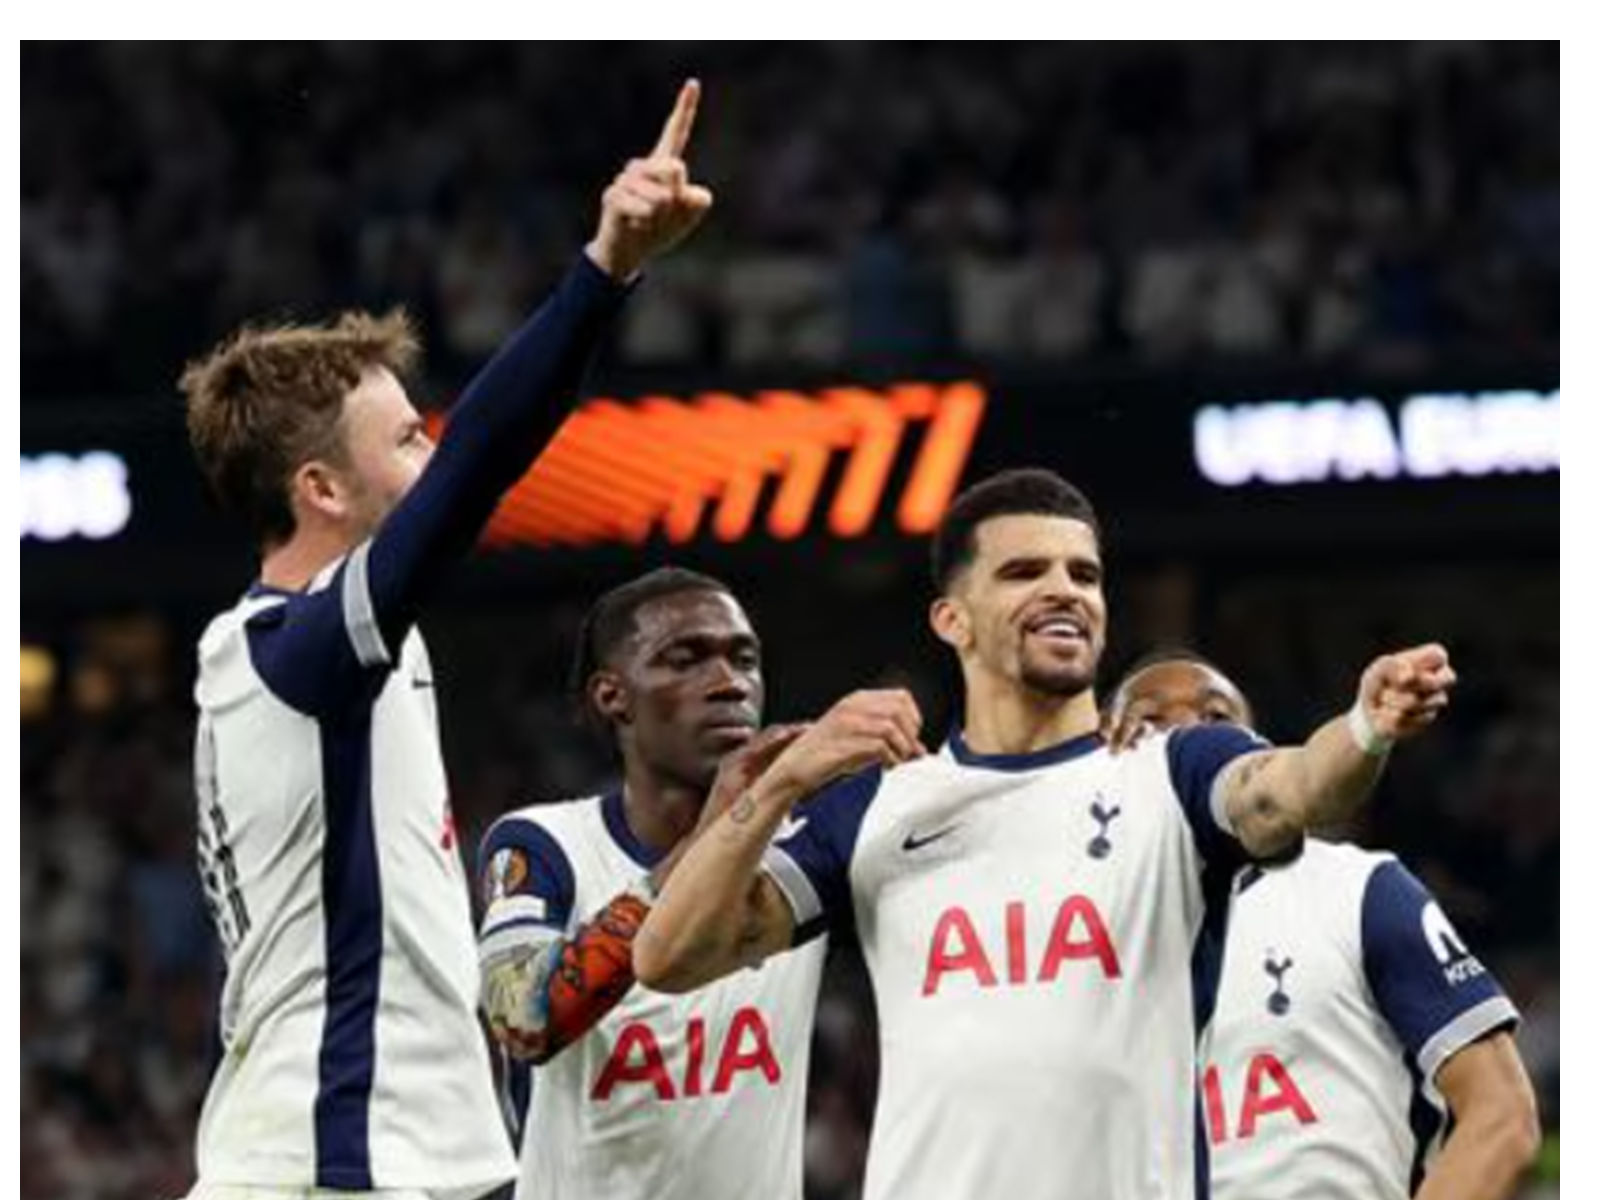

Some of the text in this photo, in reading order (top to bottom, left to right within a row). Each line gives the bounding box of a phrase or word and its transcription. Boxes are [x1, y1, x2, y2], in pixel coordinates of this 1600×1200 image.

[1402, 388, 1560, 478] EUR
[923, 894, 1123, 997] AIA
[589, 1006, 781, 1102] AIA
[1201, 1051, 1319, 1145] IA
